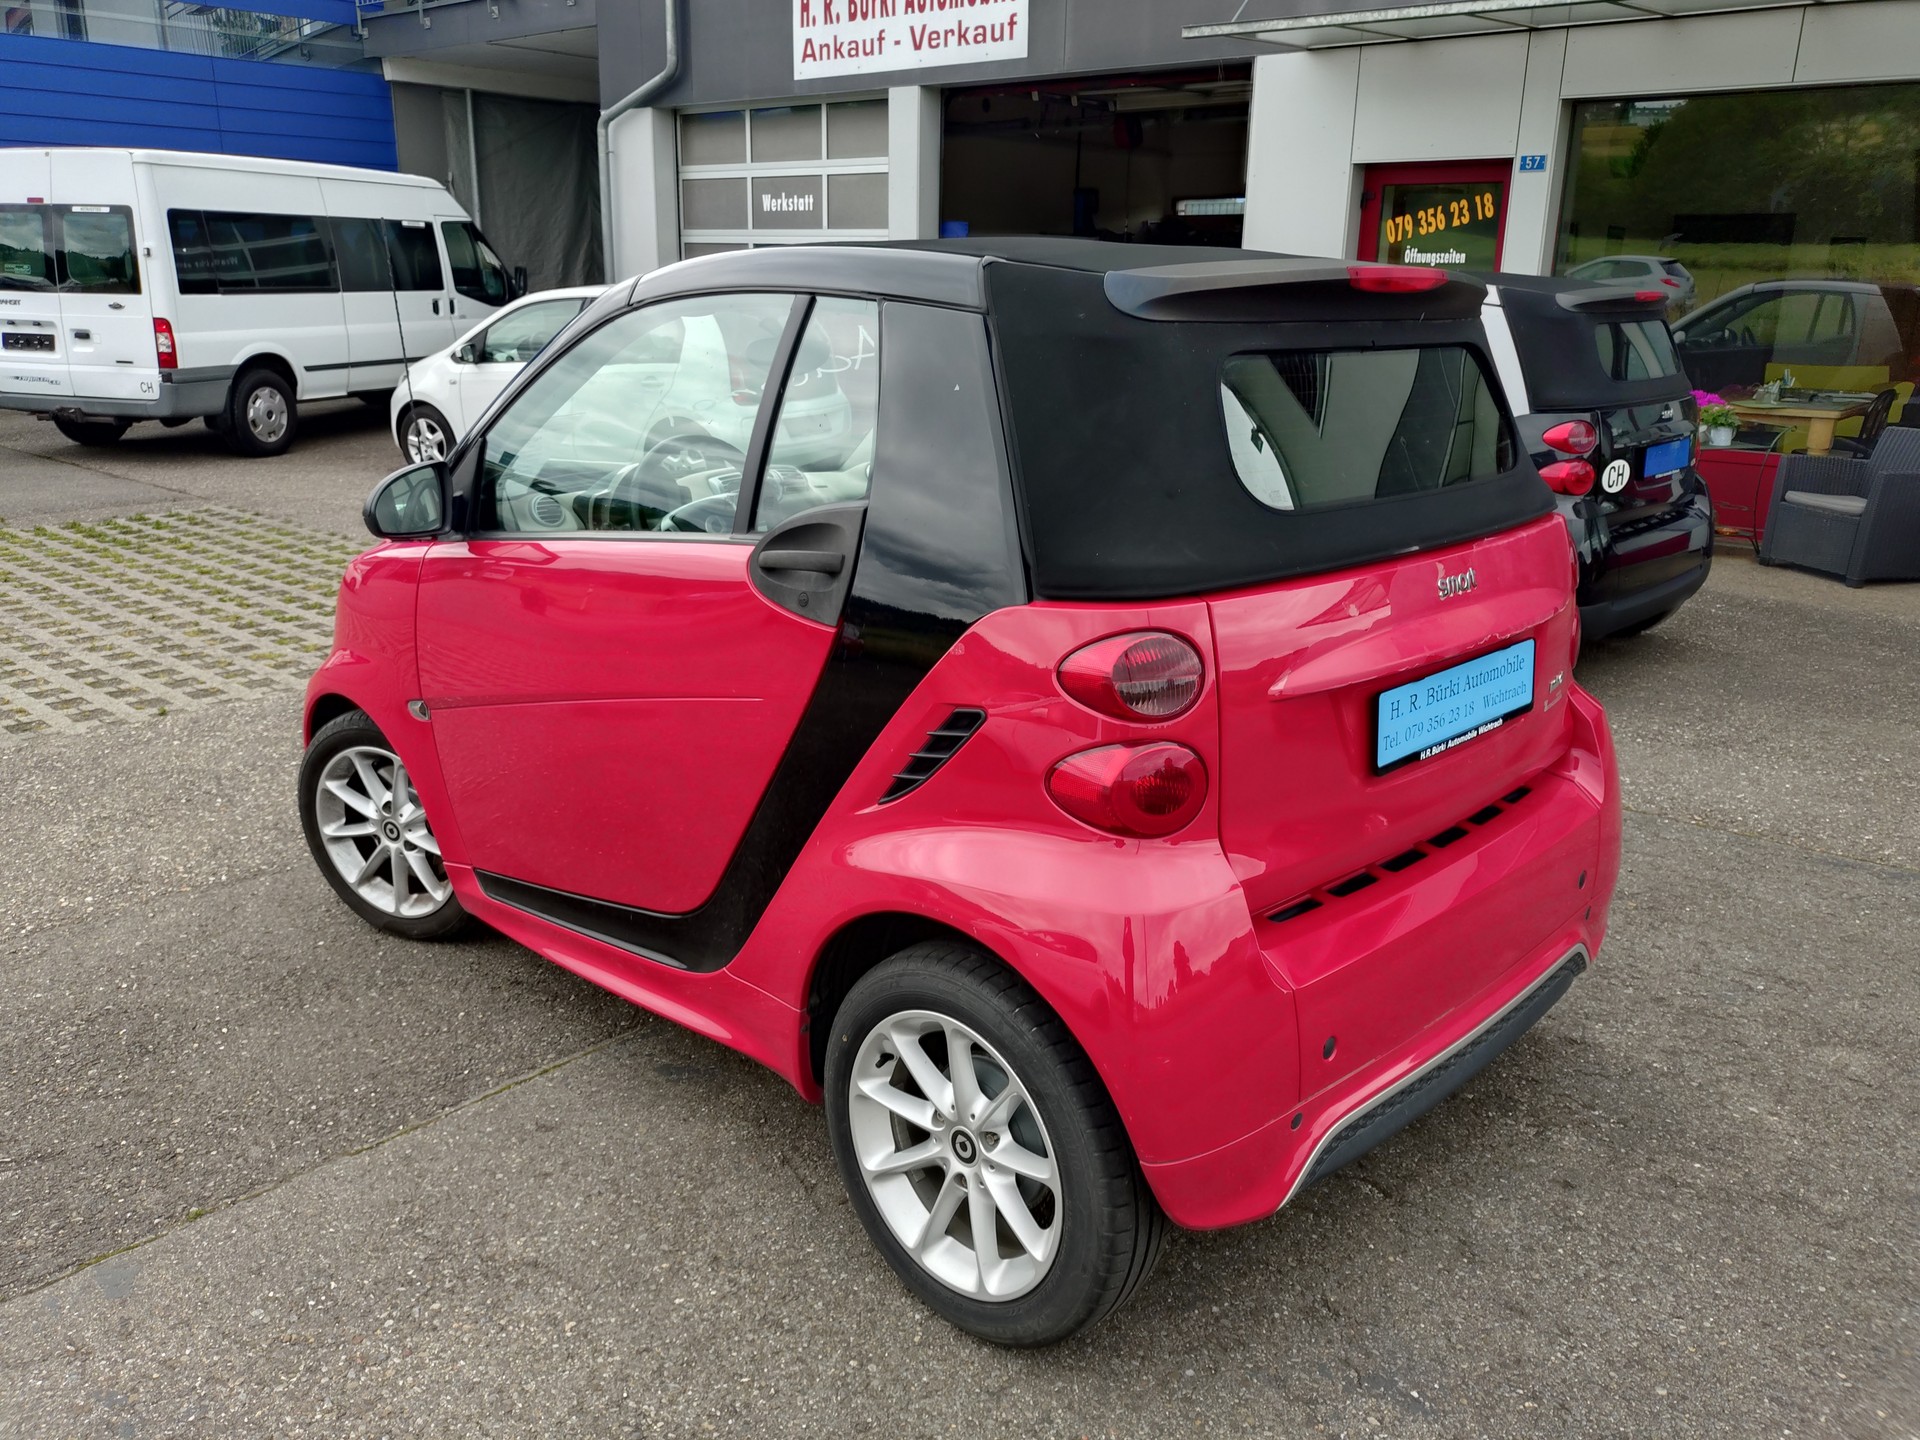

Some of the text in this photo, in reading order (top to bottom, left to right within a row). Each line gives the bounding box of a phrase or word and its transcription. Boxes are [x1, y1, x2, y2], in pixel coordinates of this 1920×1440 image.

[801, 29, 885, 64] Ankauf
[909, 13, 1018, 51] Verkauf
[1525, 157, 1540, 169] 57
[762, 192, 814, 212] Werkstatt
[1386, 192, 1494, 244] 079 356 23 18
[1404, 246, 1466, 266] Öffnungszeiten
[140, 382, 154, 394] CH
[1607, 464, 1624, 488] CH
[1390, 700, 1404, 720] H.
[1409, 694, 1421, 713] R.
[1426, 677, 1460, 706] Bürki
[1463, 654, 1525, 692] Automobile
[1383, 731, 1401, 751] Tel.
[1404, 722, 1424, 742] 079
[1426, 712, 1446, 733] 356
[1448, 707, 1460, 724] 23
[1464, 700, 1475, 718] 18
[1482, 680, 1527, 709] Wichtrach
[1447, 729, 1478, 749] Automobile
[1478, 717, 1503, 735] Wichtrach
